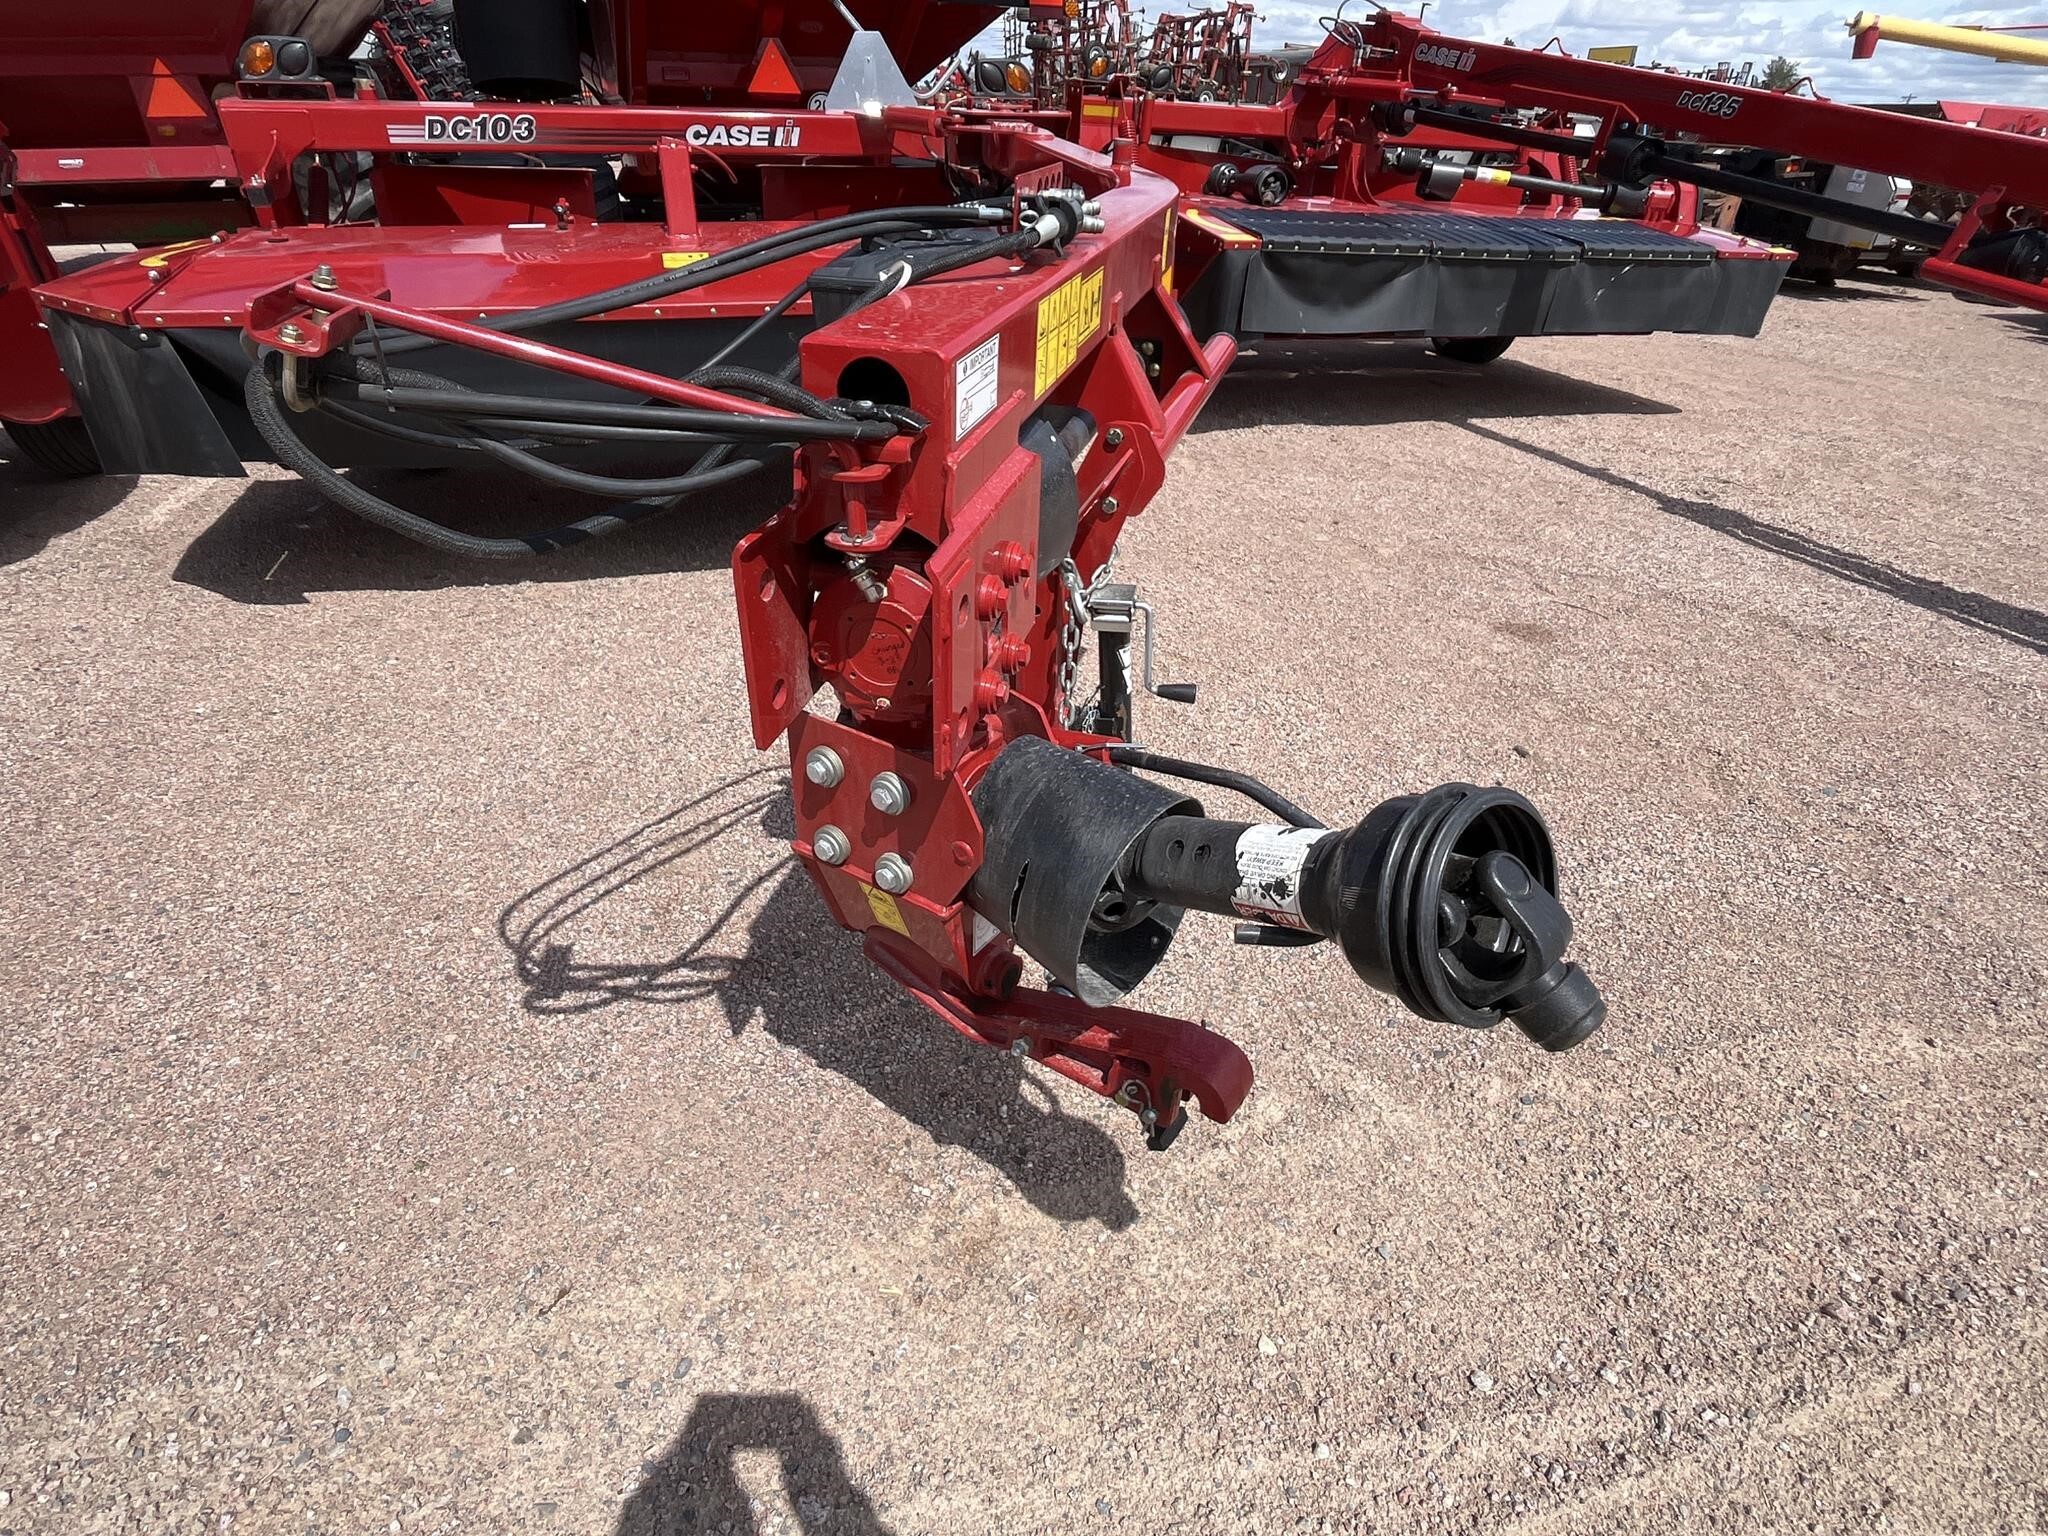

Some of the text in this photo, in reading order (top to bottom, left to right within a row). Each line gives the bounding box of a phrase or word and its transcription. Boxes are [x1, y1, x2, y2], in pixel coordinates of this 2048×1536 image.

[1415, 43, 1460, 68] CASE
[1676, 90, 1744, 119] DC135
[425, 114, 536, 143] DC103
[685, 125, 771, 147] CASE
[969, 342, 996, 370] IMPORTANT
[1266, 859, 1284, 867] KEEP
